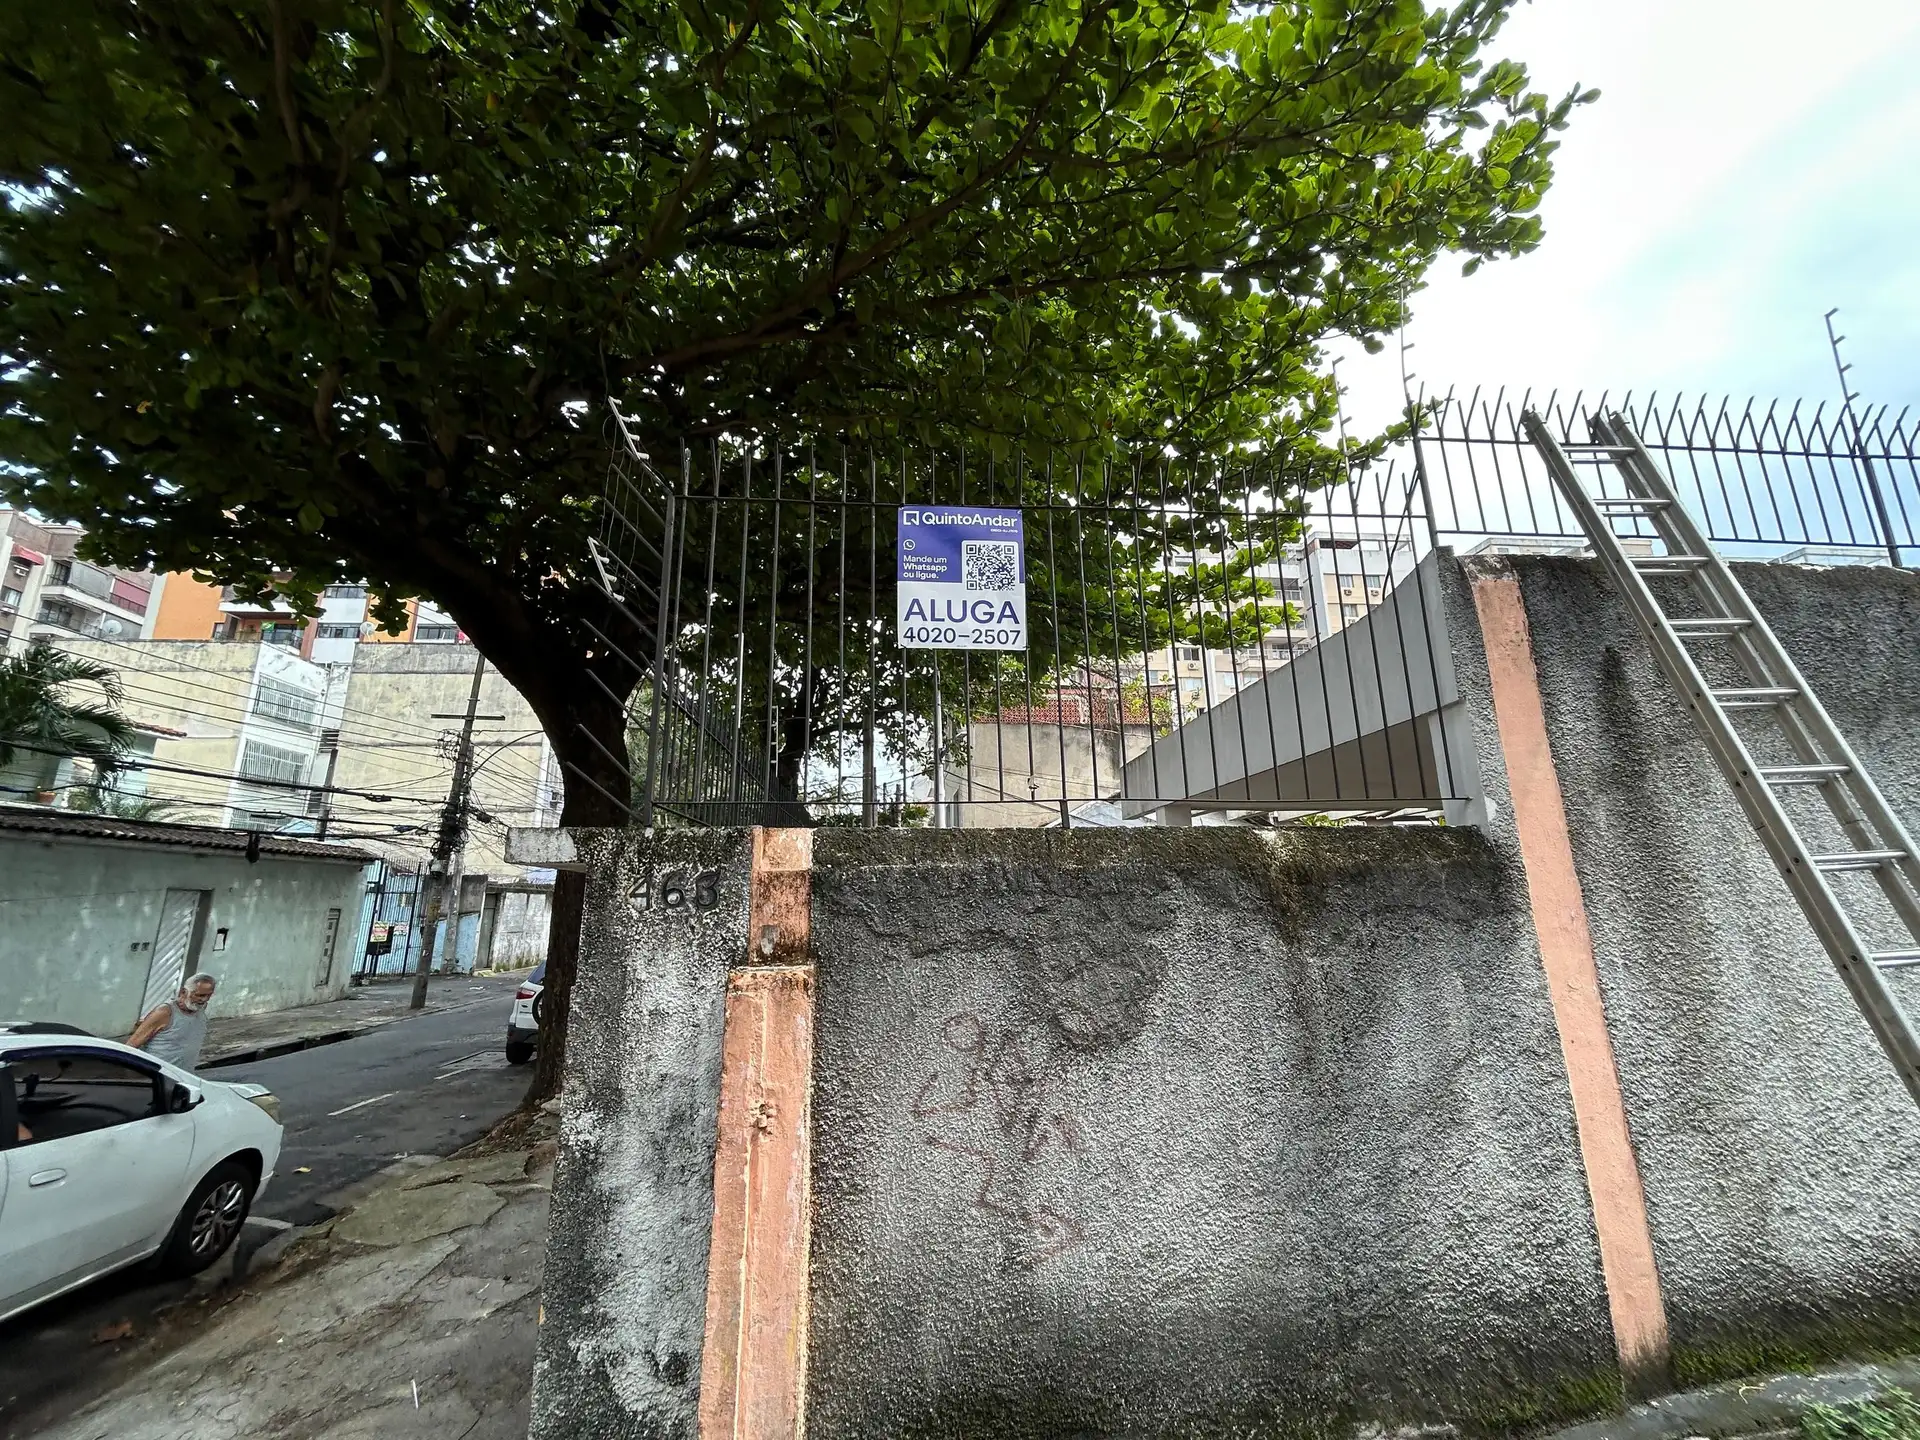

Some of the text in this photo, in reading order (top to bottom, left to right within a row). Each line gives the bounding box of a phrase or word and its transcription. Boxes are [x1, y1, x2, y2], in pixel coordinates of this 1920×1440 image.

[922, 512, 1018, 527] QuintoAndar
[903, 555, 933, 563] Mande
[903, 563, 948, 572] Whatsapp
[916, 571, 939, 580] ligue.
[903, 598, 1020, 625] ALUGA
[903, 627, 1021, 645] 4020-2507
